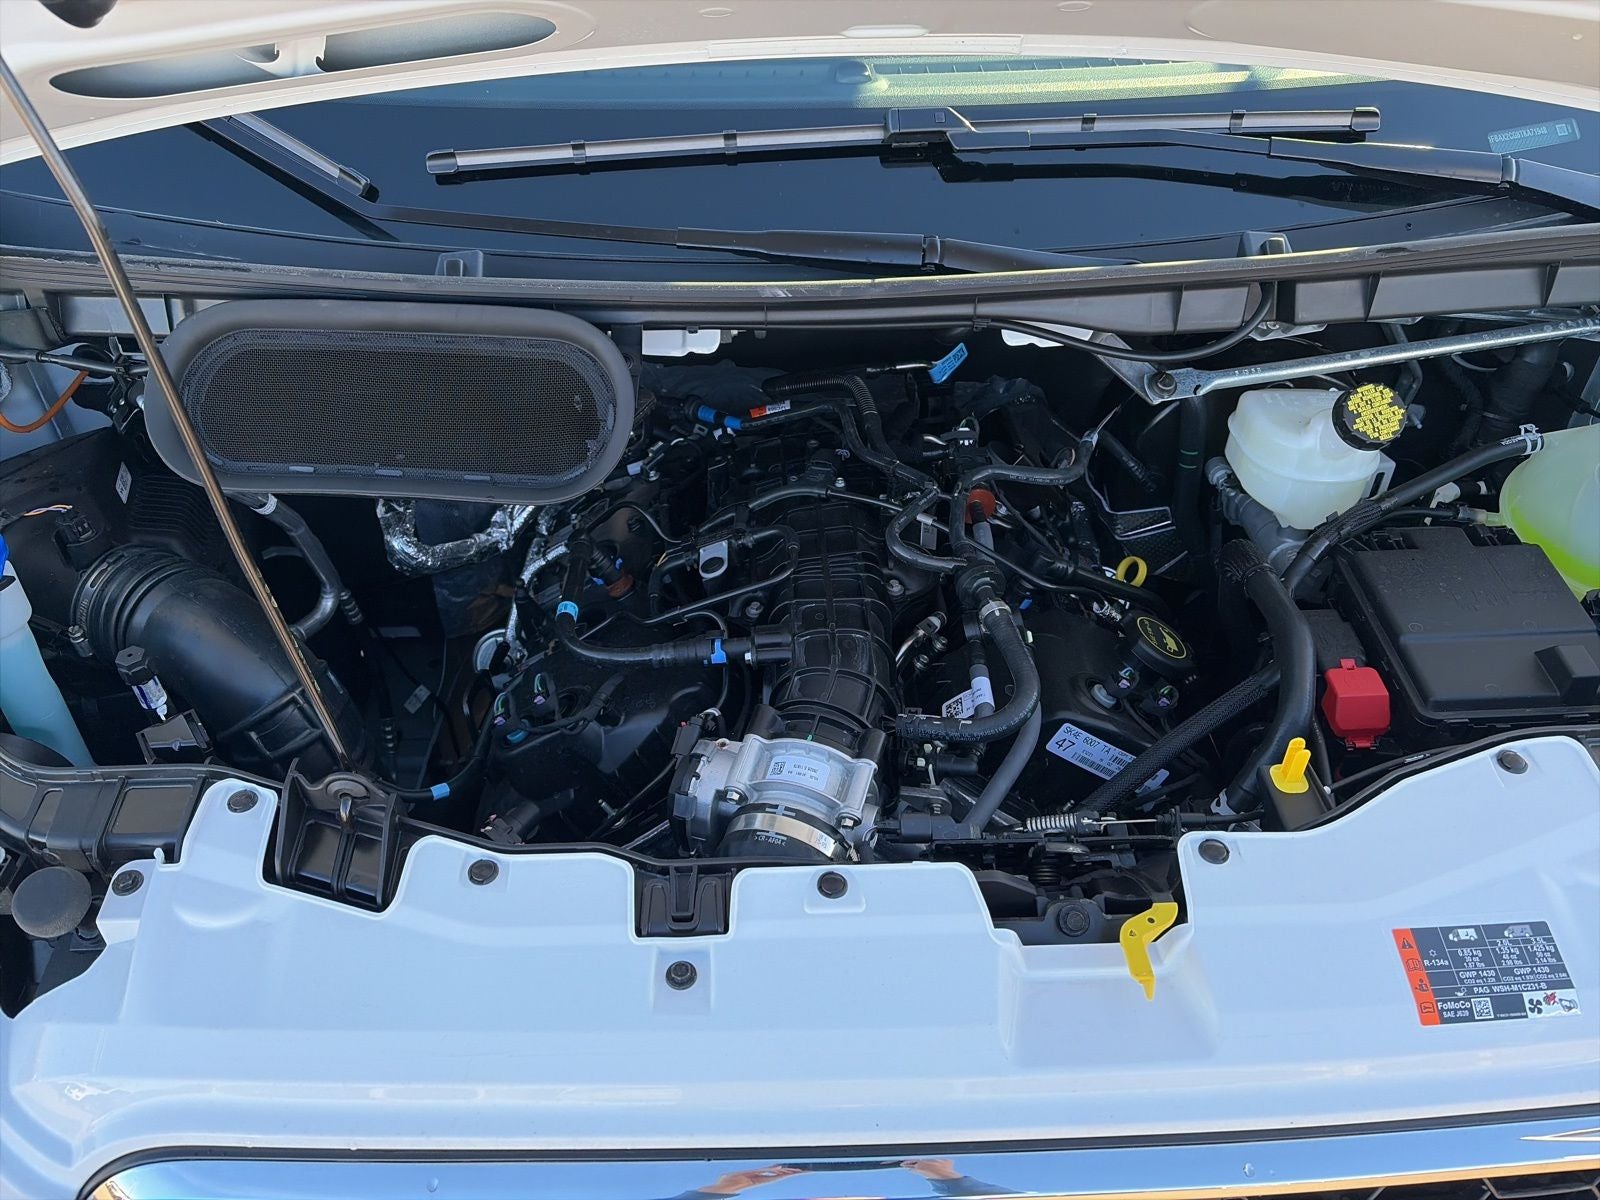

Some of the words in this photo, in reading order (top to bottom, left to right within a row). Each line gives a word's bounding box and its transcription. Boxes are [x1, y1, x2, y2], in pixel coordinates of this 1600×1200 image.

[1055, 737, 1076, 752] 47
[1063, 726, 1083, 740] SK4E
[1082, 736, 1100, 748] 6007
[1101, 745, 1112, 755] TA
[1457, 949, 1472, 957] 0.85
[1472, 949, 1482, 957] kg
[1496, 946, 1510, 954] 1.35
[1510, 946, 1520, 955] kg
[1527, 944, 1545, 952] 1.425
[1545, 944, 1555, 953] kg
[1423, 959, 1449, 967] R-134a
[1459, 971, 1477, 979] GWP
[1513, 967, 1531, 975] GWP
[1532, 966, 1550, 974] 1430
[1473, 986, 1490, 994] PAG
[1491, 982, 1548, 993] WSH-M1C231-B
[1437, 1000, 1471, 1010] FoMoCo
[1442, 1010, 1456, 1018] SAE
